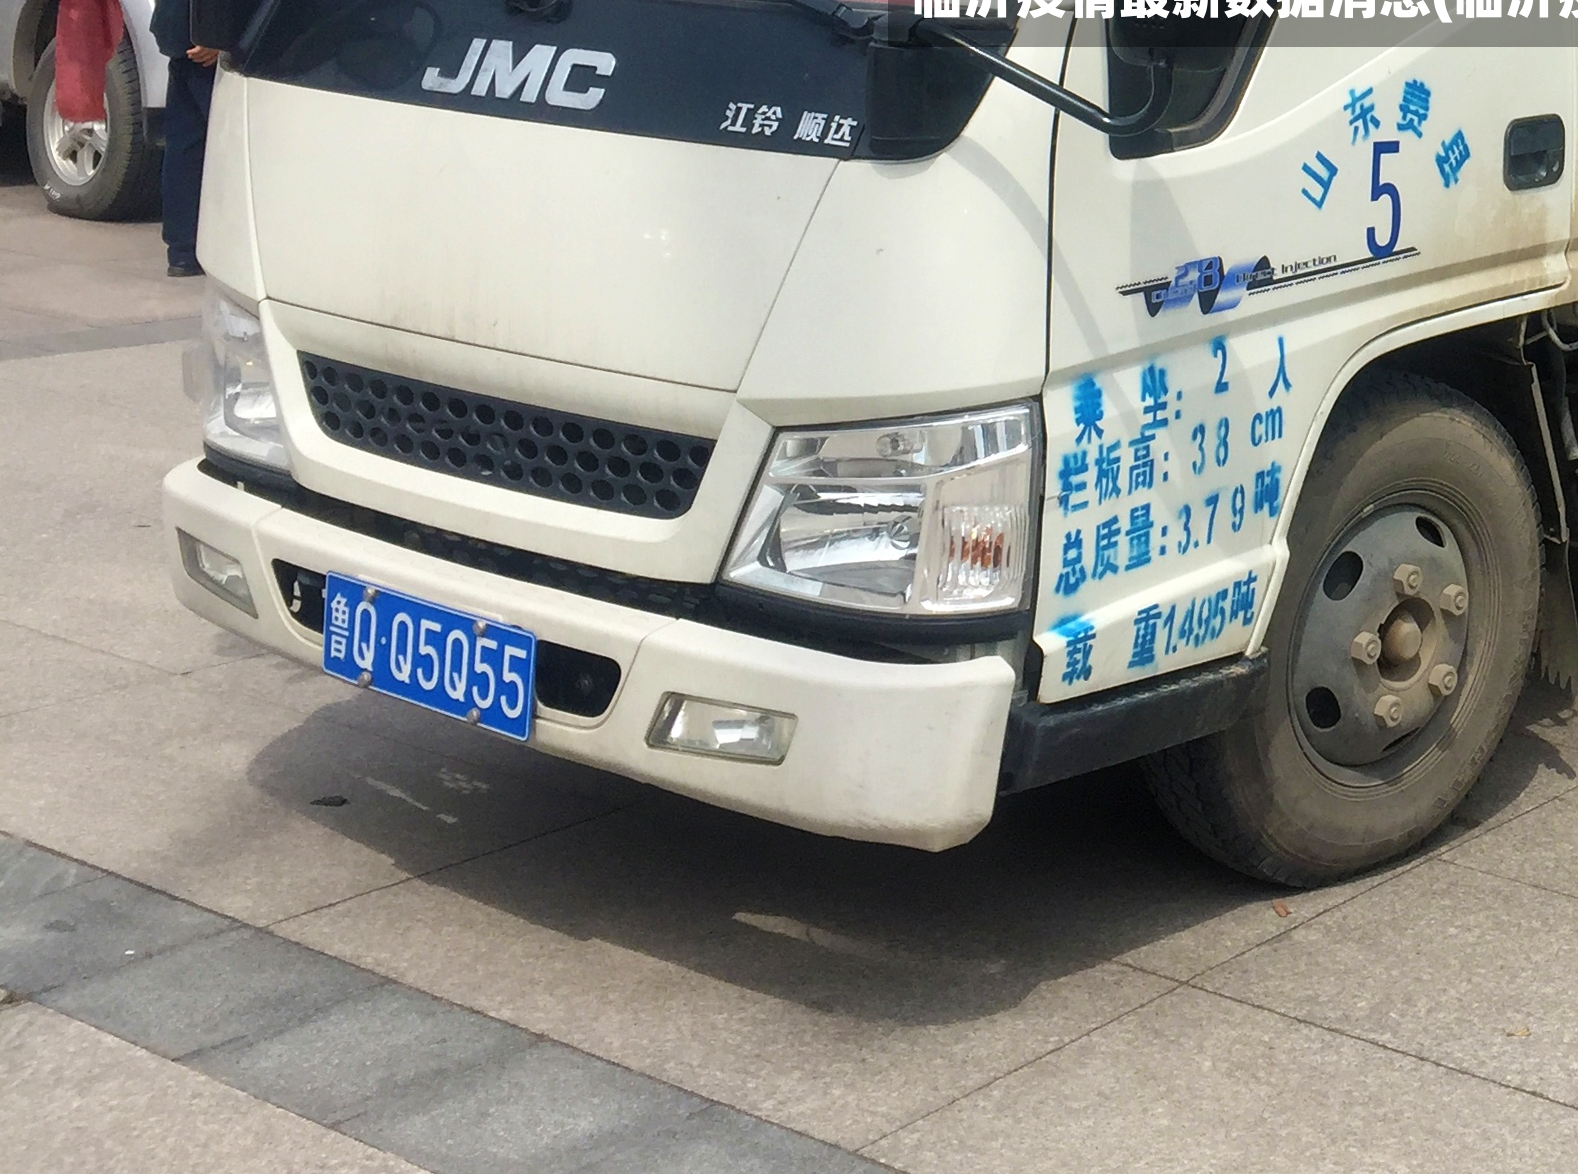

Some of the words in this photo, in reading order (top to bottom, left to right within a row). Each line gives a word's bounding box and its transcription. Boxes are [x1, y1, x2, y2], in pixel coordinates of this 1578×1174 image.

[421, 37, 617, 110] JMC
[719, 101, 783, 136] 江铃
[793, 110, 858, 148] 顺达
[1366, 140, 1402, 259] 5
[1281, 253, 1338, 276] Injection
